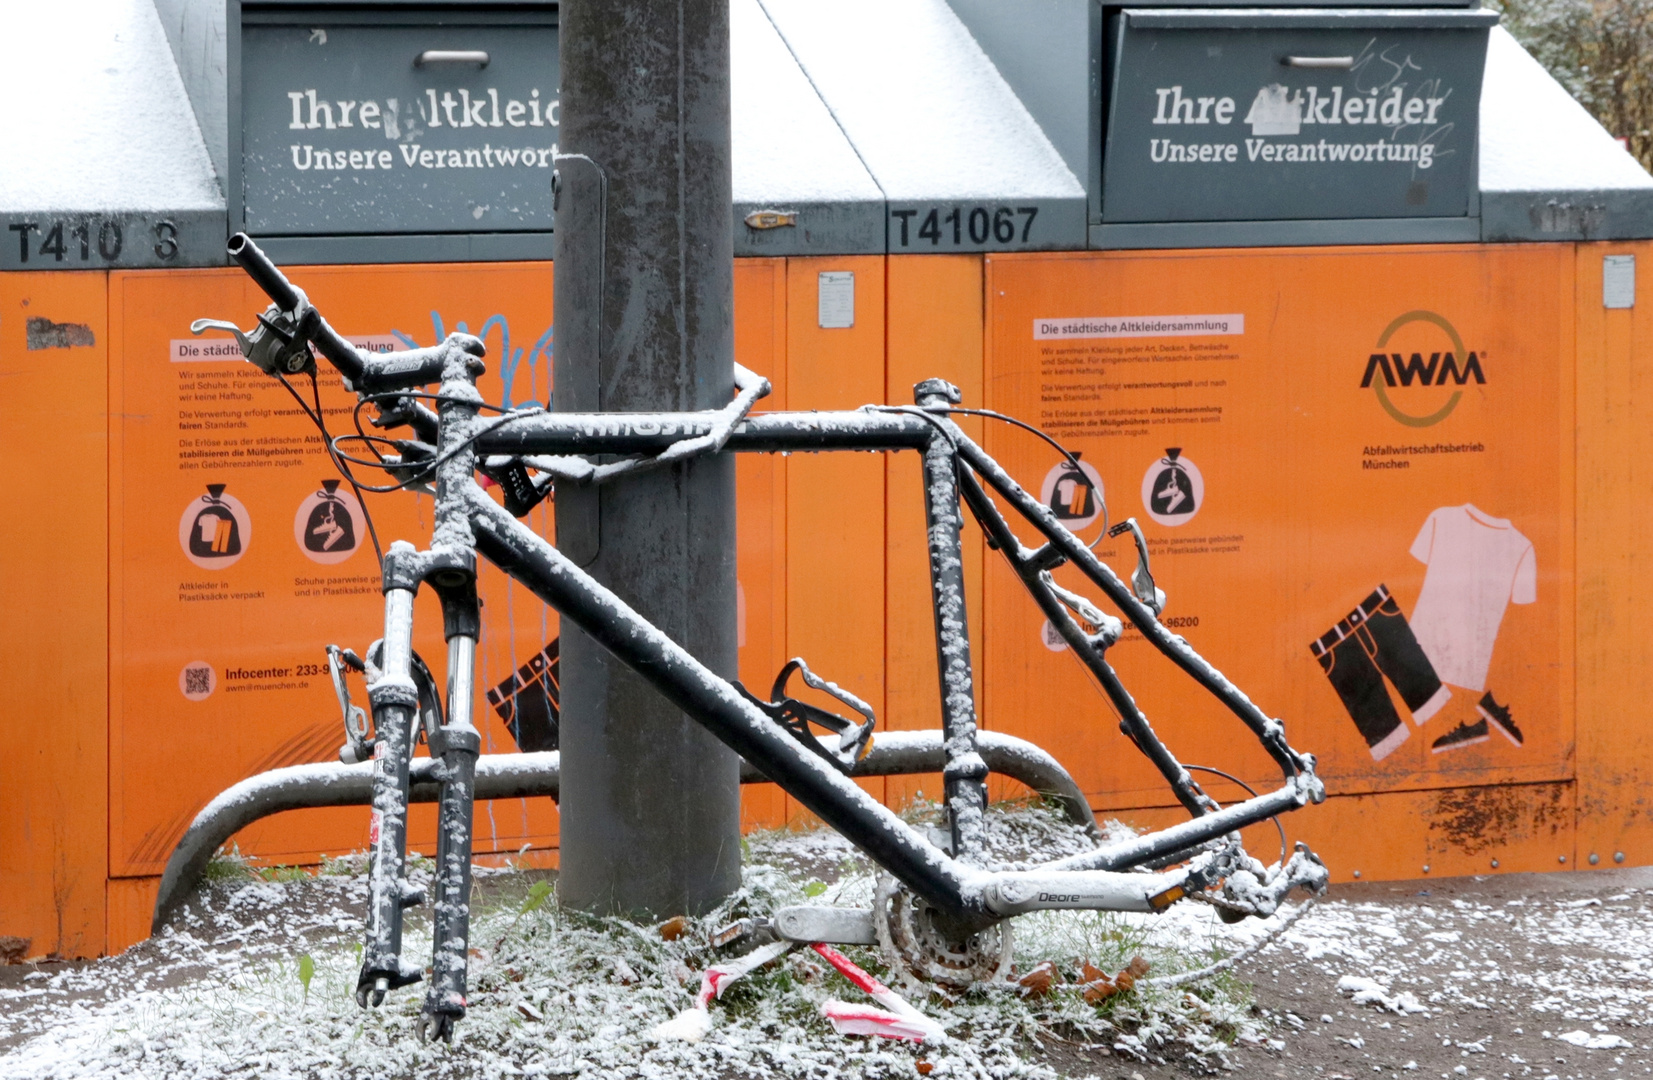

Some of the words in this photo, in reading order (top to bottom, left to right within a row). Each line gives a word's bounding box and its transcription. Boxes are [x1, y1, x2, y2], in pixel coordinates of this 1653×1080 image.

[288, 89, 381, 129] Ihre
[1153, 86, 1236, 124] Ihre
[291, 145, 392, 170] Unsere
[1150, 139, 1238, 162] Unsere
[1245, 138, 1434, 168] Verantwortung
[891, 207, 1039, 246] T41067
[1041, 323, 1058, 335] Die
[1062, 321, 1118, 334] städtische
[1120, 319, 1228, 333] Altkleidersammlung
[179, 345, 200, 356] Die
[179, 371, 193, 379] Wir
[196, 370, 234, 379] sammeln
[179, 382, 195, 390] und
[198, 381, 230, 389] Schuhe.
[233, 380, 246, 389] Für
[195, 392, 217, 400] keine
[219, 391, 254, 401] Haftung.
[179, 410, 193, 418] Die
[194, 409, 241, 419] Verwertung
[244, 408, 271, 418] erfolgt
[1151, 405, 1222, 414] Altkleidersammlung
[179, 421, 202, 430] fairen
[205, 420, 248, 429] Standards.
[195, 438, 221, 447] Erlöse
[240, 438, 253, 446] der
[256, 436, 301, 446] städtischen
[179, 450, 230, 459] stabilisieren
[232, 449, 244, 457] die
[247, 447, 303, 458] Müllgebühren
[306, 445, 322, 454] und
[1363, 442, 1485, 456] Abfallwirtschaftsbetrieb
[179, 460, 199, 469] allen
[201, 459, 272, 469] Gebührenzahlern
[275, 458, 304, 468] zugute.
[1362, 459, 1410, 470] München
[179, 581, 218, 590] Altkleider
[220, 580, 228, 589] in
[295, 577, 325, 586] Schuhe
[328, 576, 369, 586] paarweise
[179, 592, 229, 602] Plastiksäcke
[231, 590, 265, 600] verpackt
[295, 588, 311, 597] und
[313, 588, 321, 596] in
[323, 586, 371, 596] Plastiksäcke
[225, 667, 293, 680] Infocenter:
[225, 680, 309, 692] awm@muenchen.de
[1038, 892, 1080, 902] Deore
